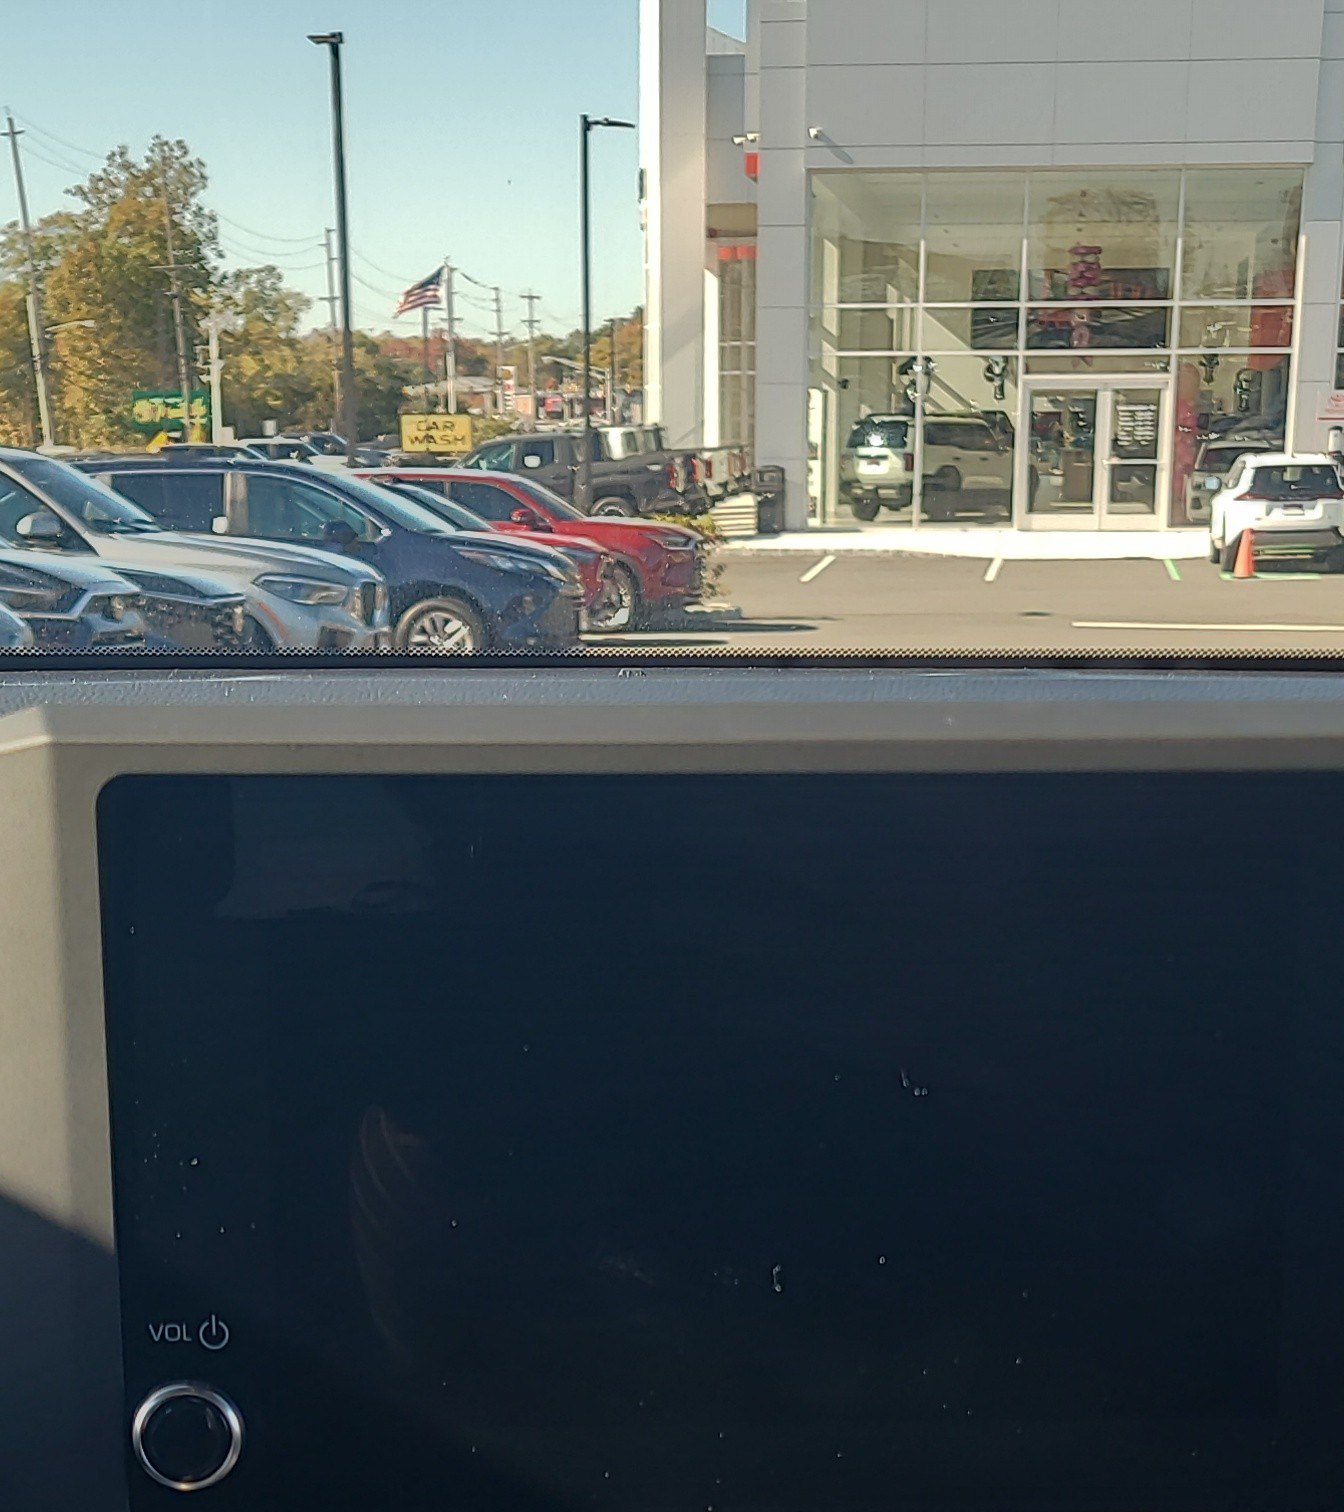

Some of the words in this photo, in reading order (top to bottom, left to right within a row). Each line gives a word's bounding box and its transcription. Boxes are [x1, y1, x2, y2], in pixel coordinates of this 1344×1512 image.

[417, 420, 456, 432] CAR
[408, 434, 465, 445] WASH
[149, 1322, 192, 1342] VOL
